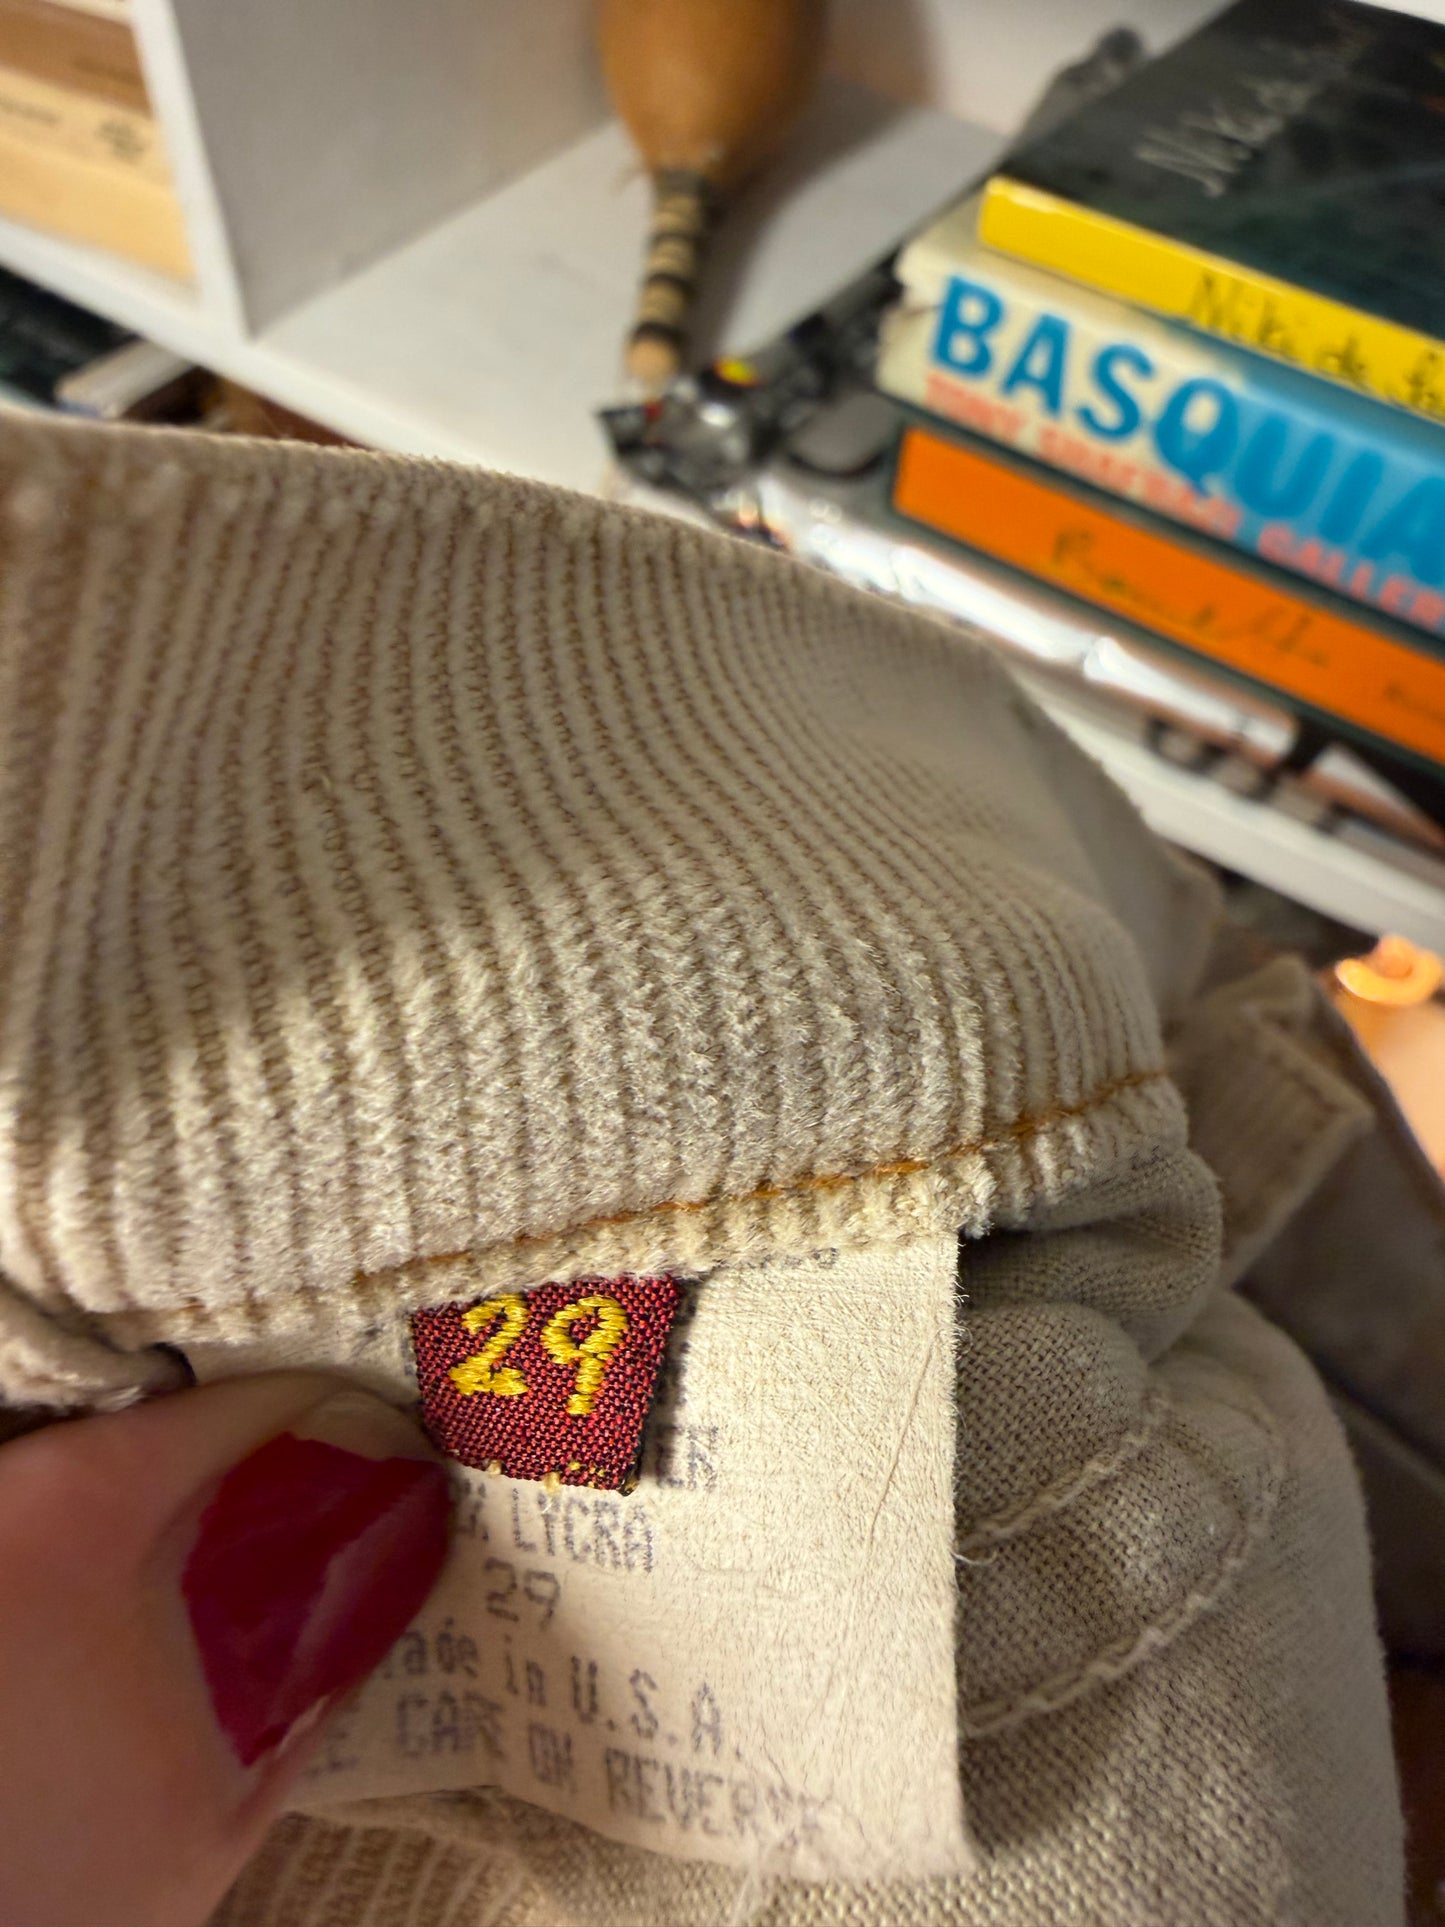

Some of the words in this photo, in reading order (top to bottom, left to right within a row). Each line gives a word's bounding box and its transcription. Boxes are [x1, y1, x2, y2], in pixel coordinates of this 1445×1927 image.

[930, 274, 1445, 586] BASQUIA
[448, 1293, 629, 1417] 29
[510, 1487, 654, 1574] LYCRA
[484, 1555, 561, 1633] 29
[384, 1616, 480, 1681] ade
[503, 1633, 547, 1707] in
[569, 1654, 744, 1762] U.S.A.
